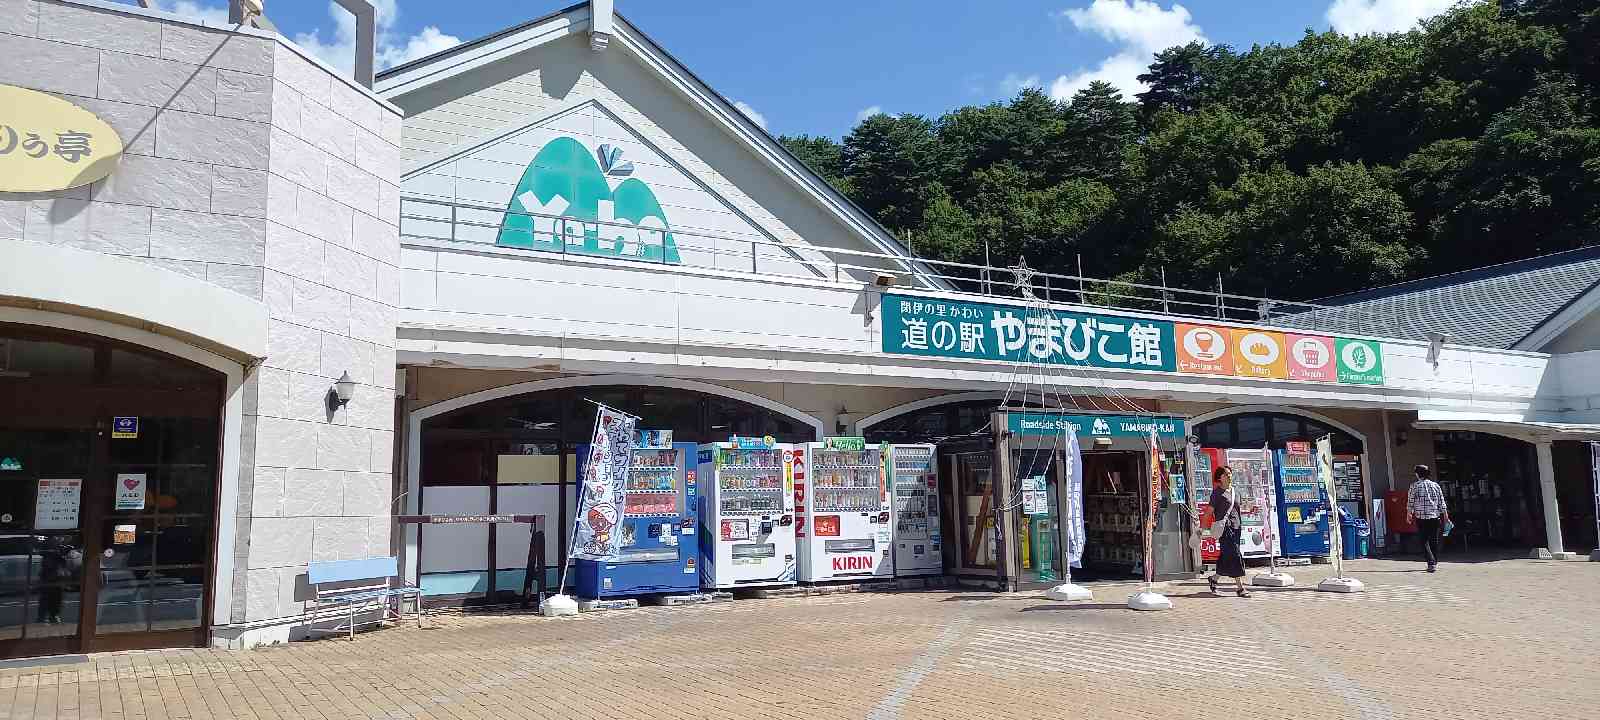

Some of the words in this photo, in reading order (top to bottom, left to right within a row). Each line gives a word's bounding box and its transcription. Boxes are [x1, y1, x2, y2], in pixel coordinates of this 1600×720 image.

[949, 306, 984, 319] かわい
[900, 317, 986, 354] 道の駅
[991, 310, 1163, 366] やまびこ館
[1020, 420, 1054, 430] Roadside
[1056, 420, 1081, 432] Station
[1120, 422, 1175, 433] YAMABIKO-KAN
[793, 449, 806, 538] KIRIN
[832, 556, 873, 571] KIRIN
